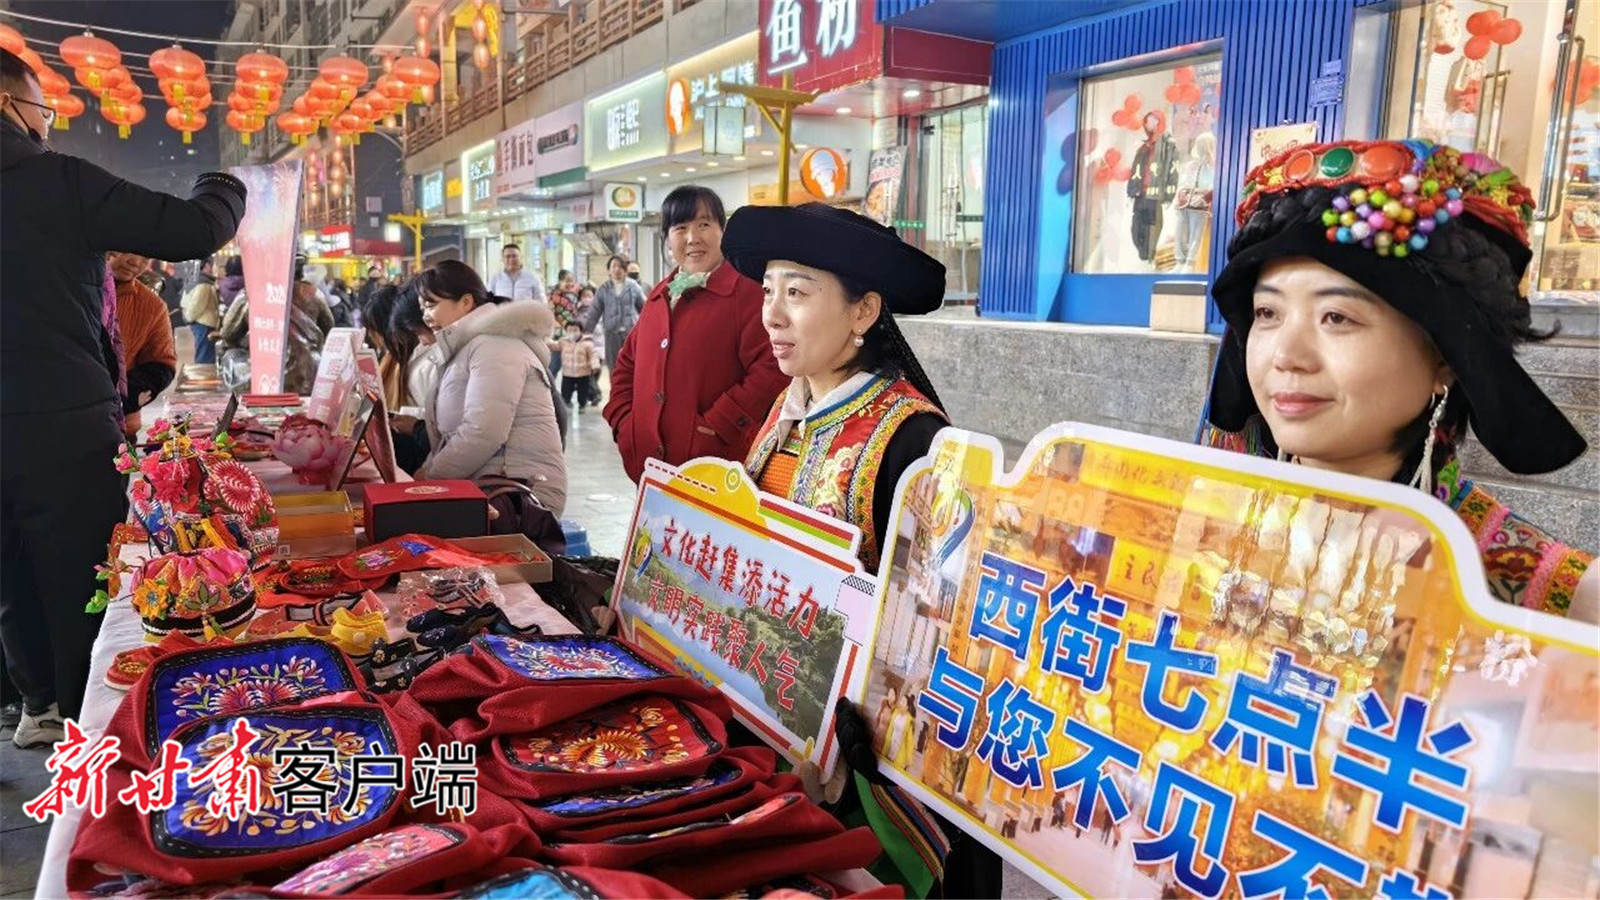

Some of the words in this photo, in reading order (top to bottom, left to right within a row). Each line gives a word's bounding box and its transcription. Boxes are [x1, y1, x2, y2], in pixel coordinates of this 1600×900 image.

[767, 0, 858, 75] 鱼粉
[647, 573, 801, 711] 文明实践聚人气
[661, 517, 819, 639] 文化赶集添活力
[968, 550, 1474, 833] 西街七点半
[918, 647, 1452, 900] 与您不见不
